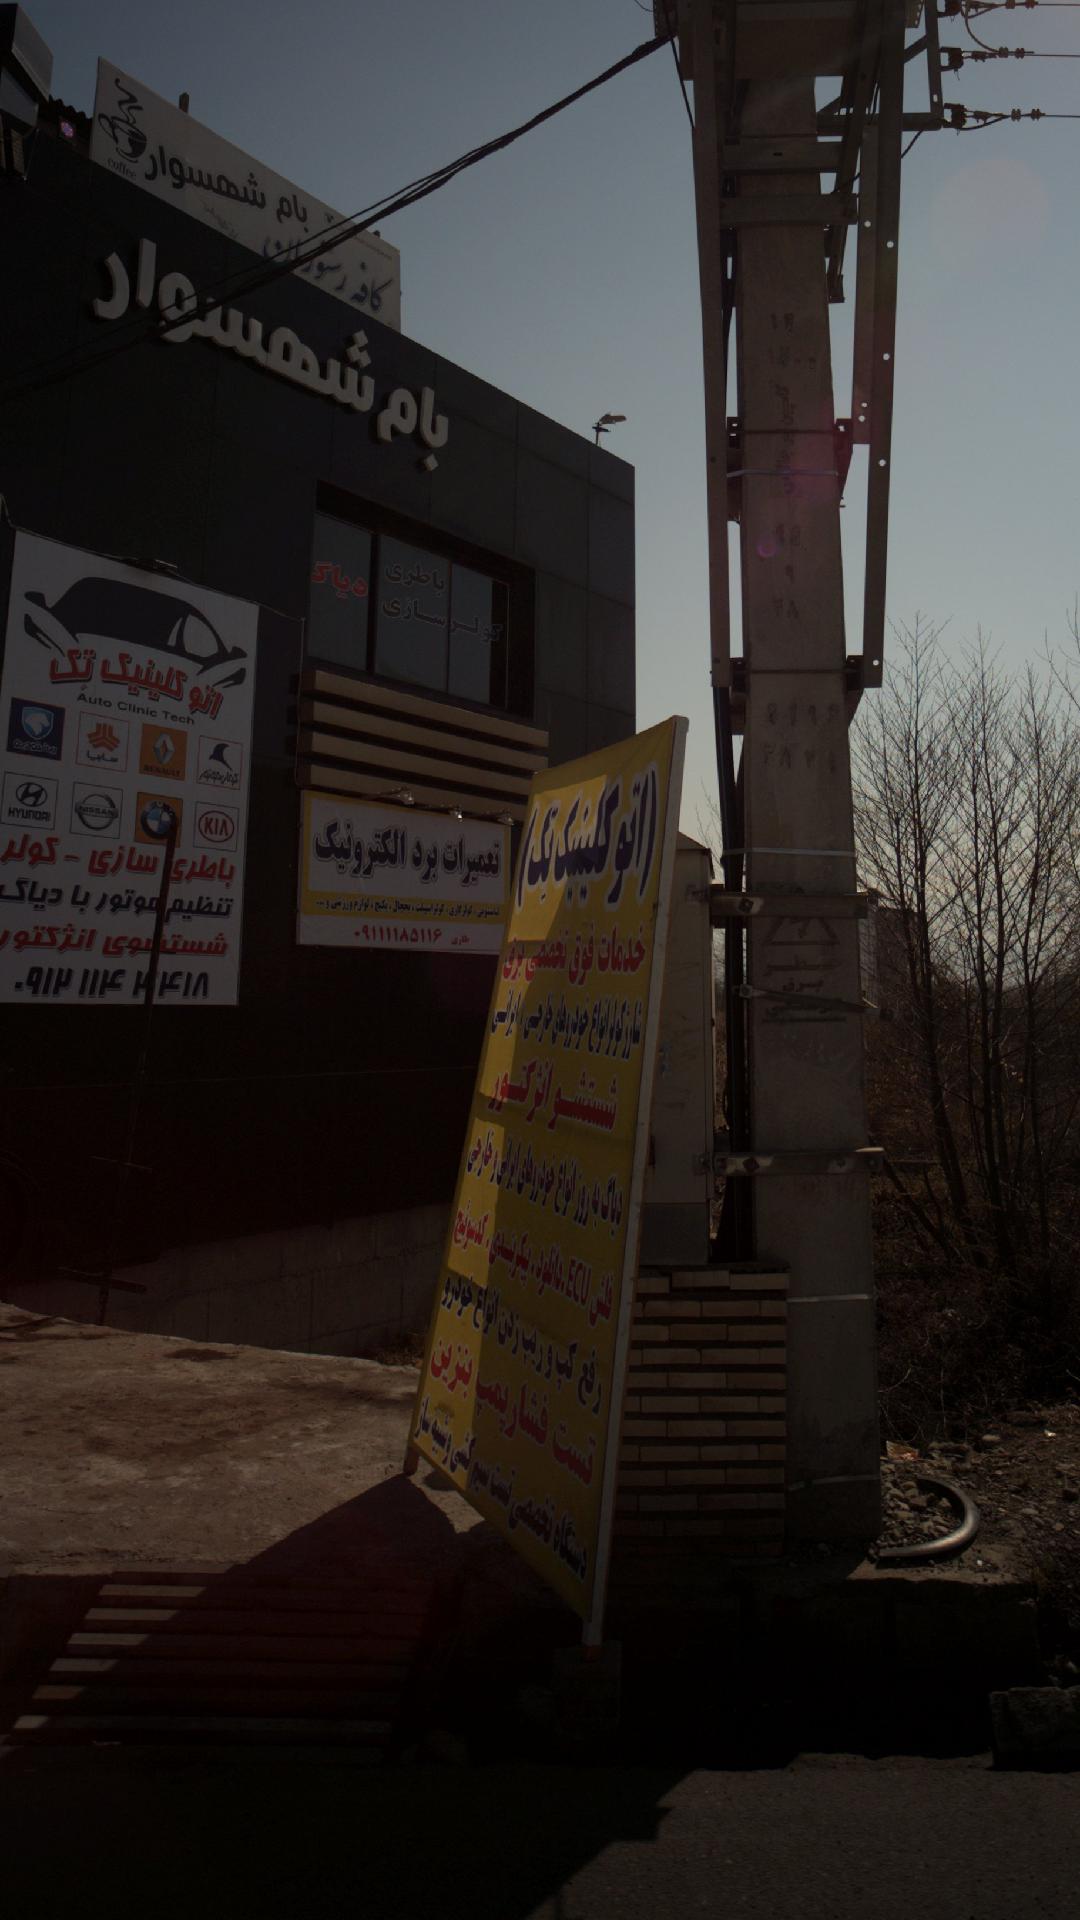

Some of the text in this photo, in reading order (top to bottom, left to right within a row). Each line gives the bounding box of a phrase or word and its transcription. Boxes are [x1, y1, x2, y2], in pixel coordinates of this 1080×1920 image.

[144, 144, 266, 209] شهسوار
[276, 193, 309, 233] بام
[91, 238, 449, 471] بام شهسوار
[385, 563, 445, 596] باطری
[382, 599, 446, 626] سازی
[101, 653, 187, 702] کلینیک
[77, 693, 195, 726] Auto Clinic Tech
[189, 685, 223, 720] اتو
[8, 807, 51, 821] HYUNDAI
[79, 806, 113, 816] NISSAN
[205, 817, 228, 836] KIA
[0, 834, 59, 868] کولر
[88, 846, 159, 876] سازی
[315, 821, 500, 884] تعمیرات برد الکترونیک
[170, 853, 235, 888] باطری
[71, 884, 90, 913] با
[95, 889, 160, 914] موتور
[164, 896, 234, 922] تنظیم
[564, 1258, 592, 1306] ECU
